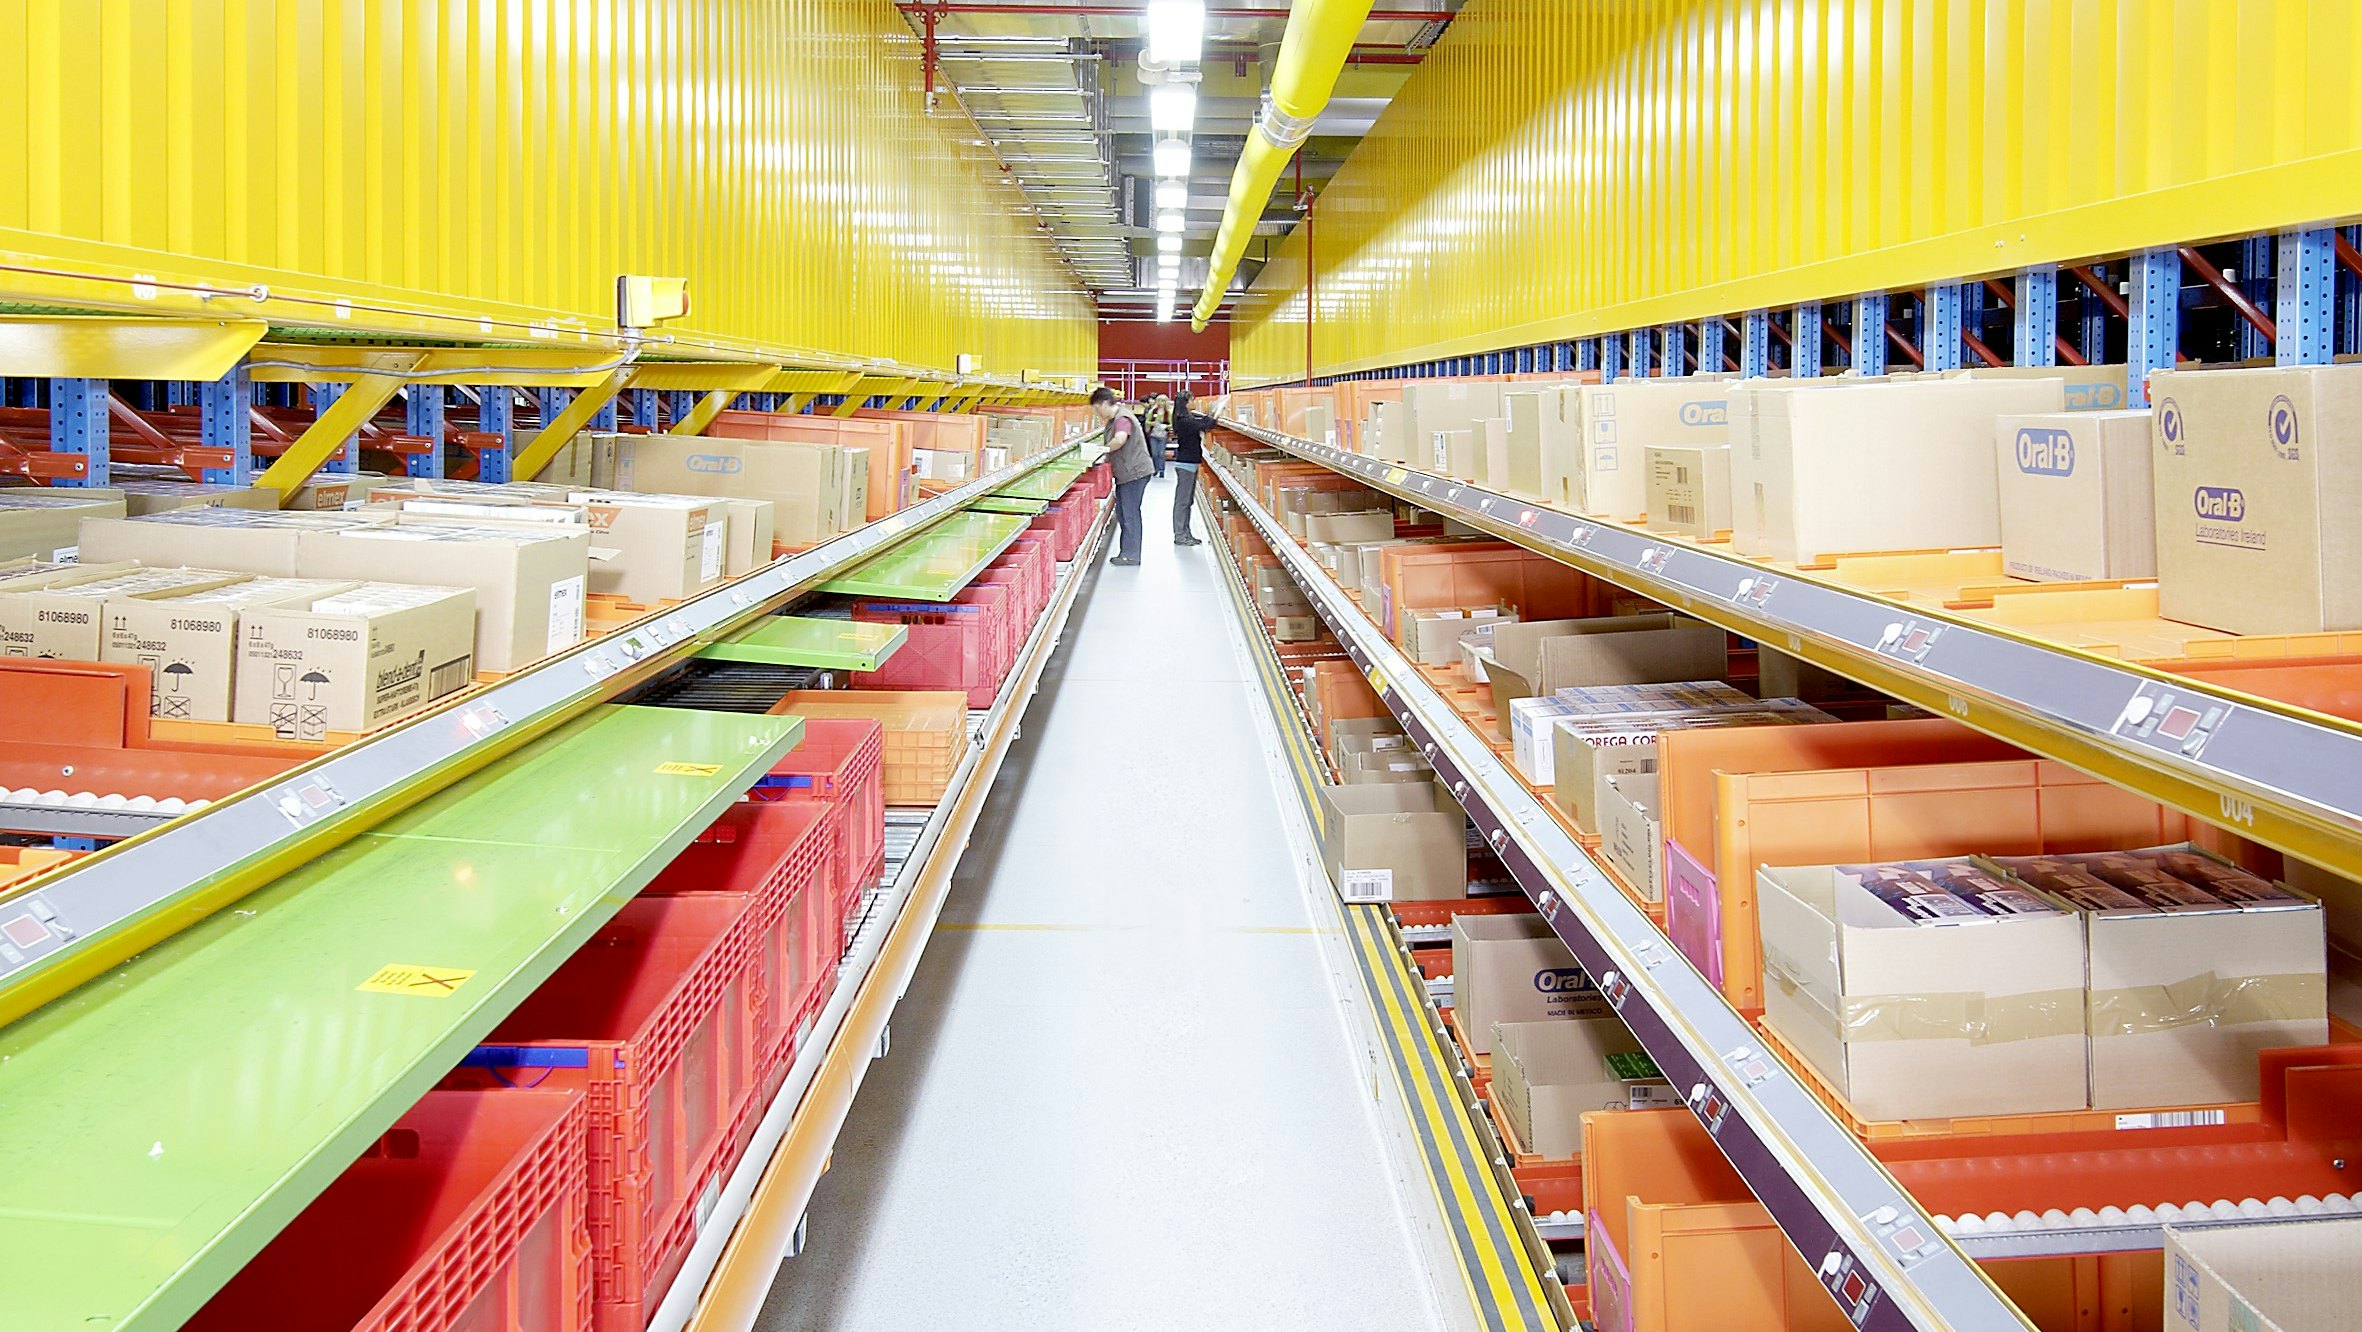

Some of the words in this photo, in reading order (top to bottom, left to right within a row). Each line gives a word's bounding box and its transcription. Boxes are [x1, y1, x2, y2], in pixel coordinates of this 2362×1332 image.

[2064, 386, 2115, 405] ral-B
[1684, 403, 1727, 423] Ora
[2019, 433, 2071, 470] Oral-B
[317, 490, 345, 507] elmex
[2197, 489, 2241, 518] Oral-B
[2196, 523, 2239, 542] Laboratories
[2240, 527, 2266, 545] Ireland
[59, 555, 78, 563] elme
[38, 610, 89, 625] 81068980
[170, 618, 222, 633] 81068980
[4, 631, 35, 643] 248632
[307, 627, 359, 642] 81068980
[136, 640, 167, 651] 248632
[272, 649, 303, 660] 248632
[1582, 736, 1627, 746] OREGA
[1538, 971, 1594, 990] Oral
[1547, 994, 1602, 1004] Laboratories
[1547, 1009, 1566, 1017] MADE
[1576, 1008, 1603, 1016] MEXICO
